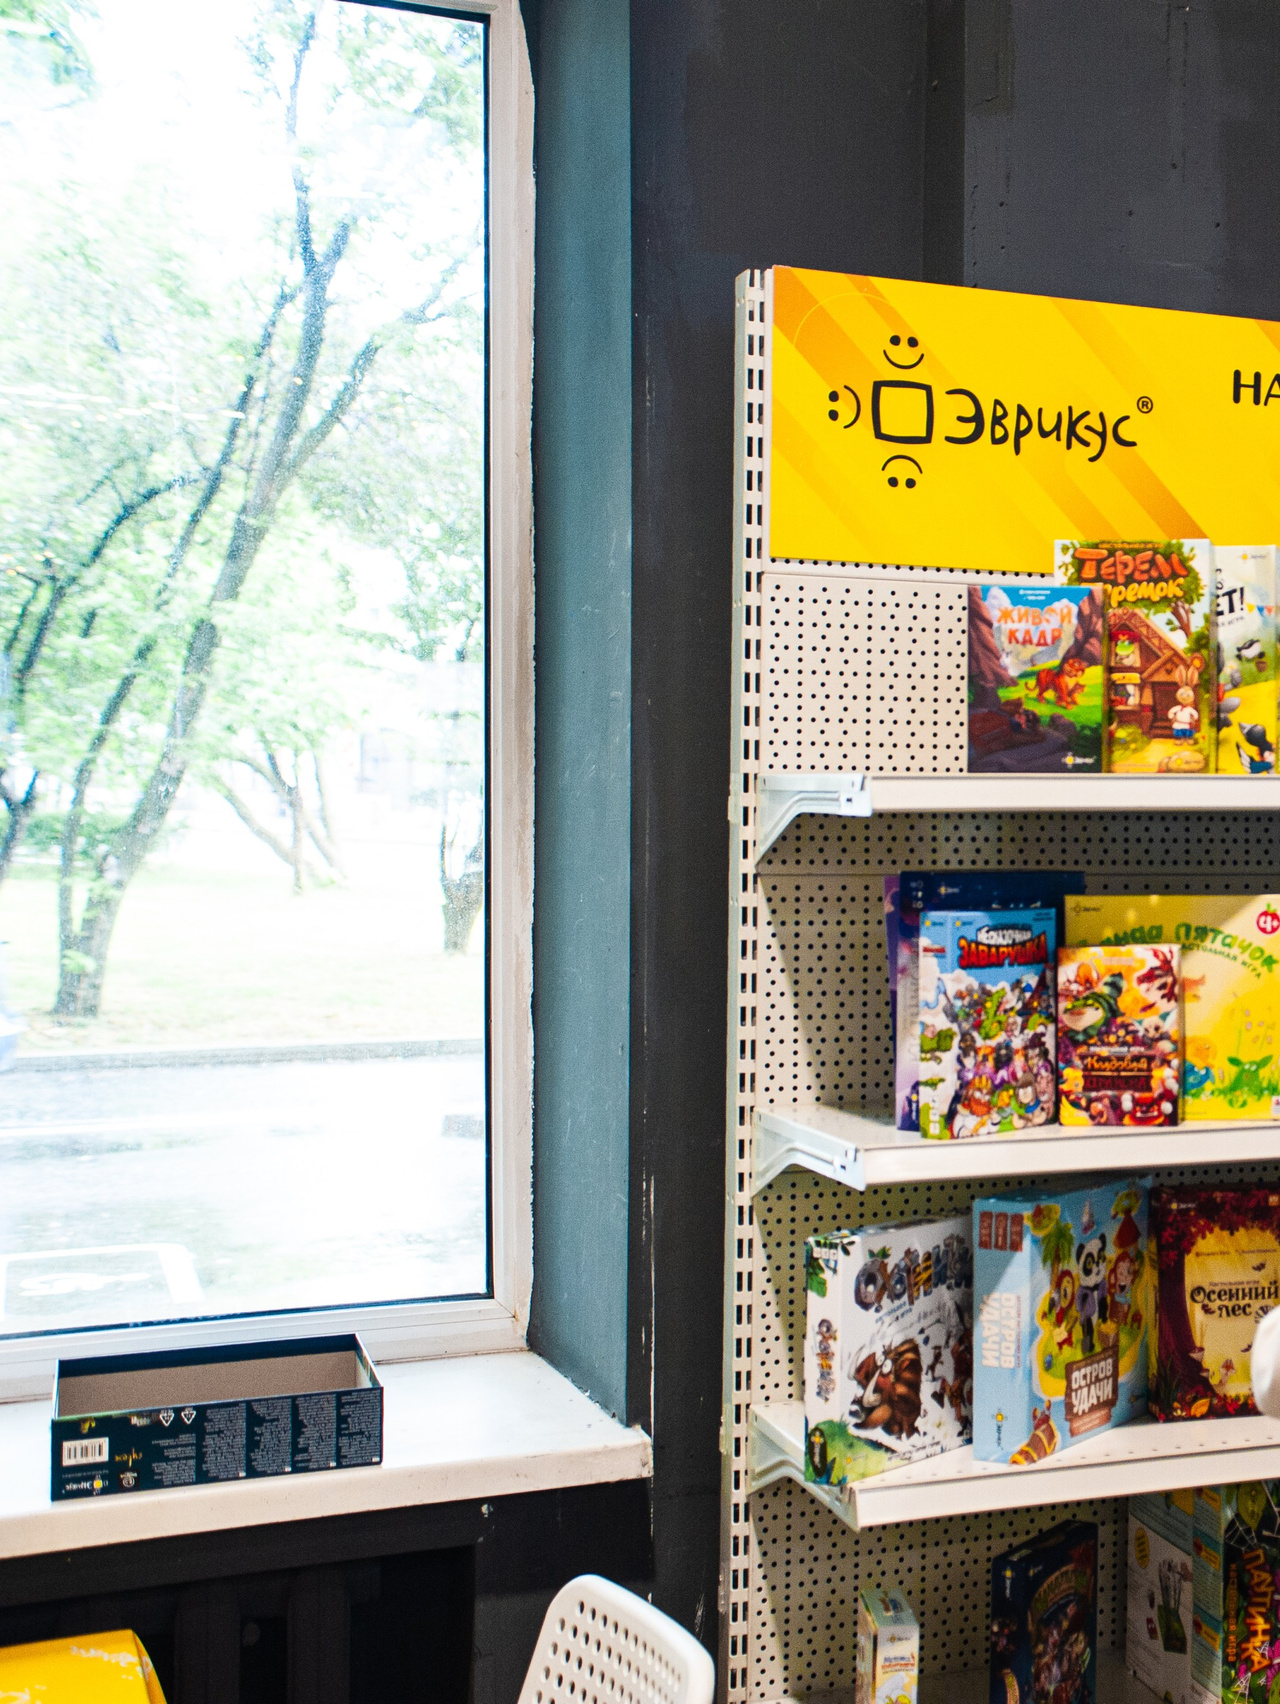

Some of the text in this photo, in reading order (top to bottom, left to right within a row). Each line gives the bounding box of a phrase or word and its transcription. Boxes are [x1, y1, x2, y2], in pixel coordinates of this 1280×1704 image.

[997, 605, 1072, 626] ЖИВОЙ
[1008, 628, 1062, 647] КАДР
[1258, 914, 1280, 932] 4+
[958, 931, 1048, 969] ЗАВАРУШКА
[1190, 1280, 1279, 1304] Осенний
[1217, 1303, 1252, 1318] лес
[979, 1292, 1001, 1369] УДАЧИ
[1001, 1293, 1016, 1370] ОСТРОВ
[1072, 1357, 1114, 1390] ОСТРОВ
[1072, 1378, 1113, 1416] УДАЧИ
